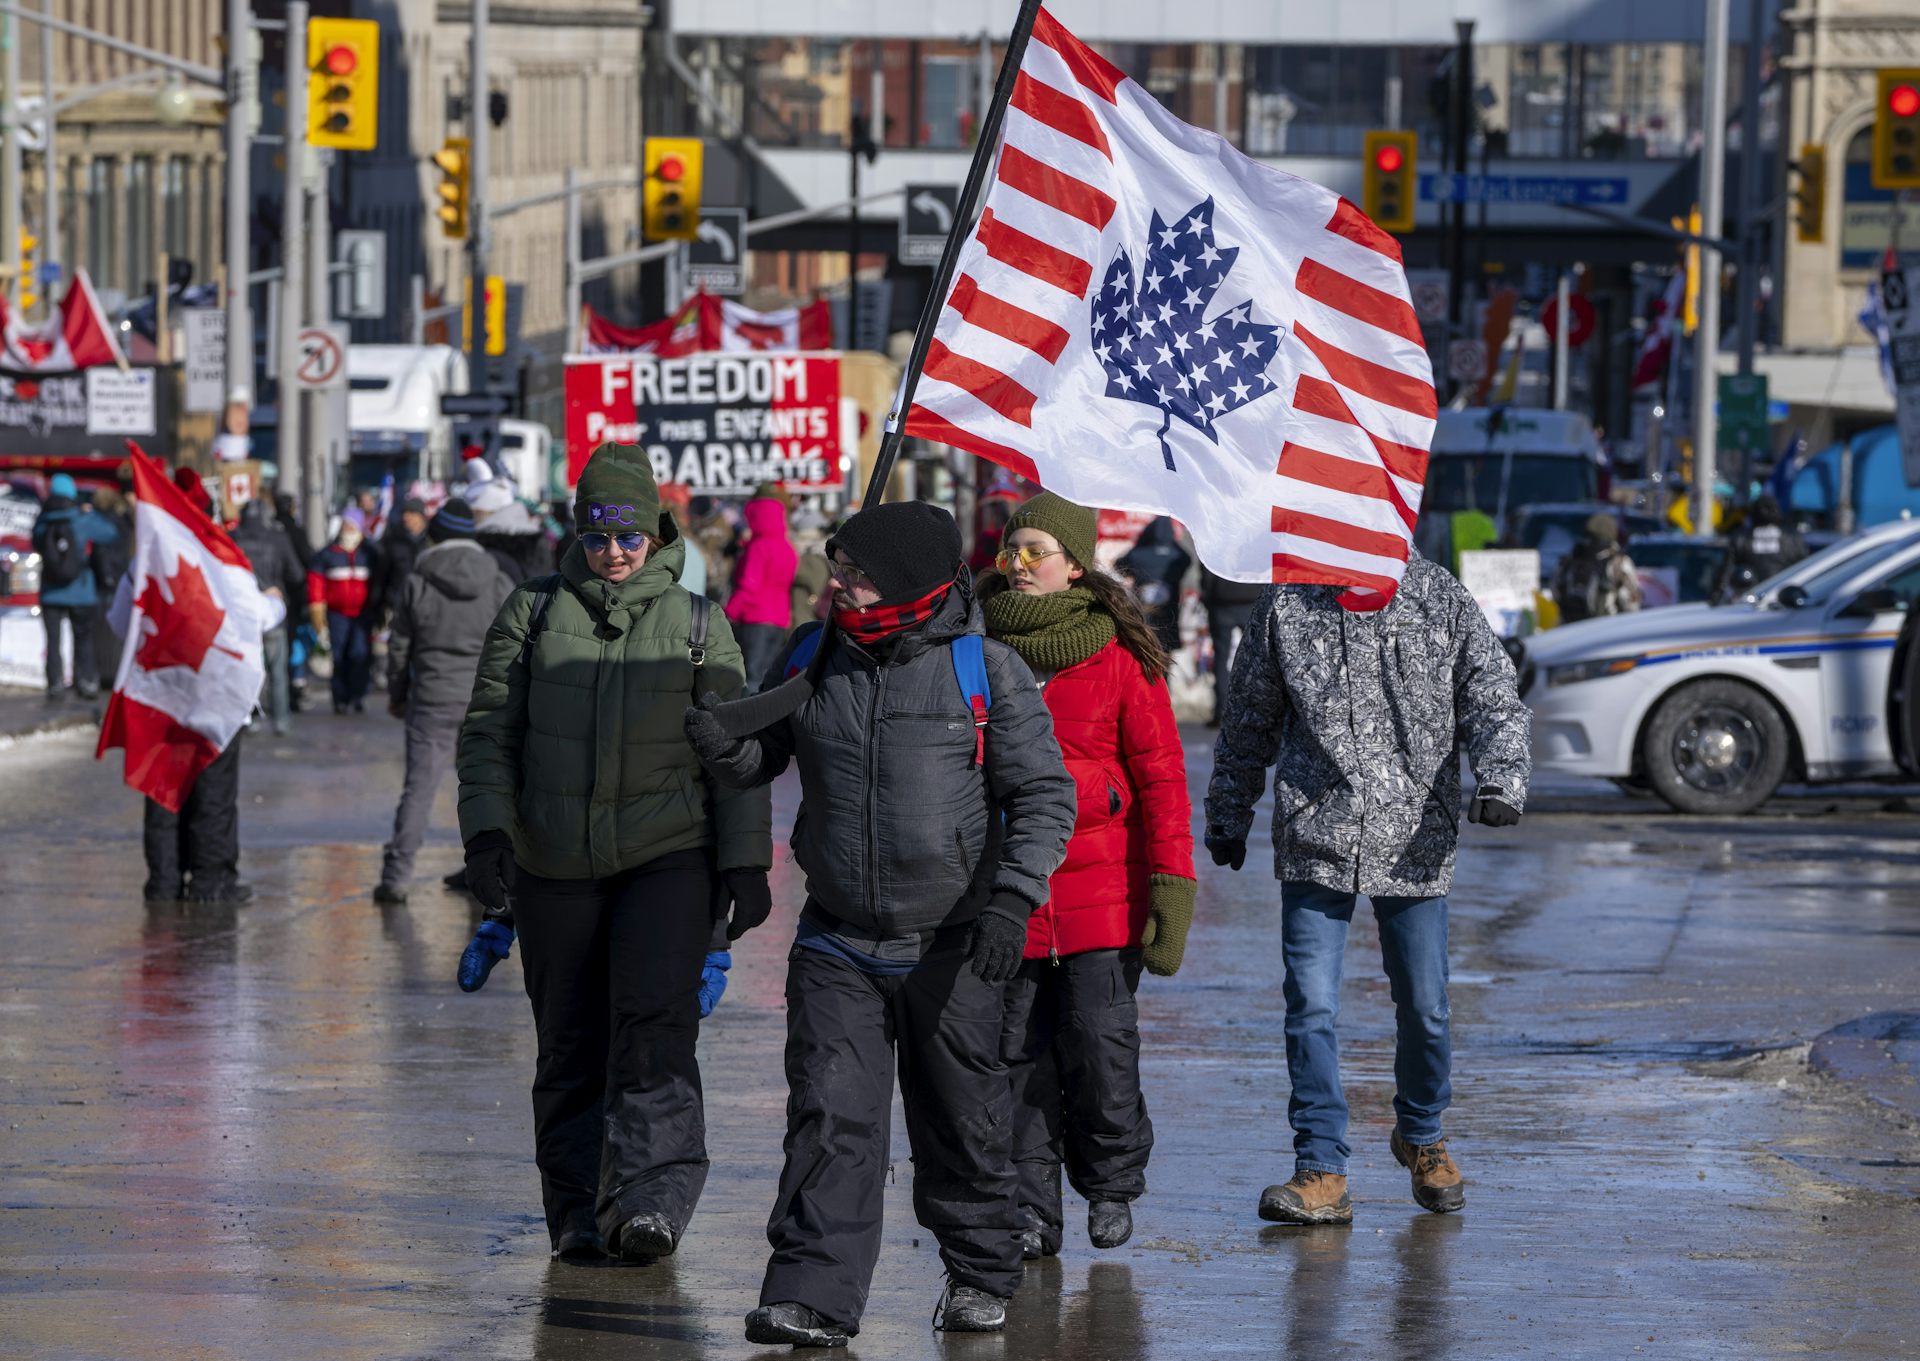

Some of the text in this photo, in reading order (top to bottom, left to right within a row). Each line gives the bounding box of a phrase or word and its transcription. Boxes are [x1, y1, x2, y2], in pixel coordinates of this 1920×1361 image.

[602, 357, 808, 405] FREEDOM
[714, 407, 828, 439] ENFANTS
[587, 503, 636, 526] PPC
